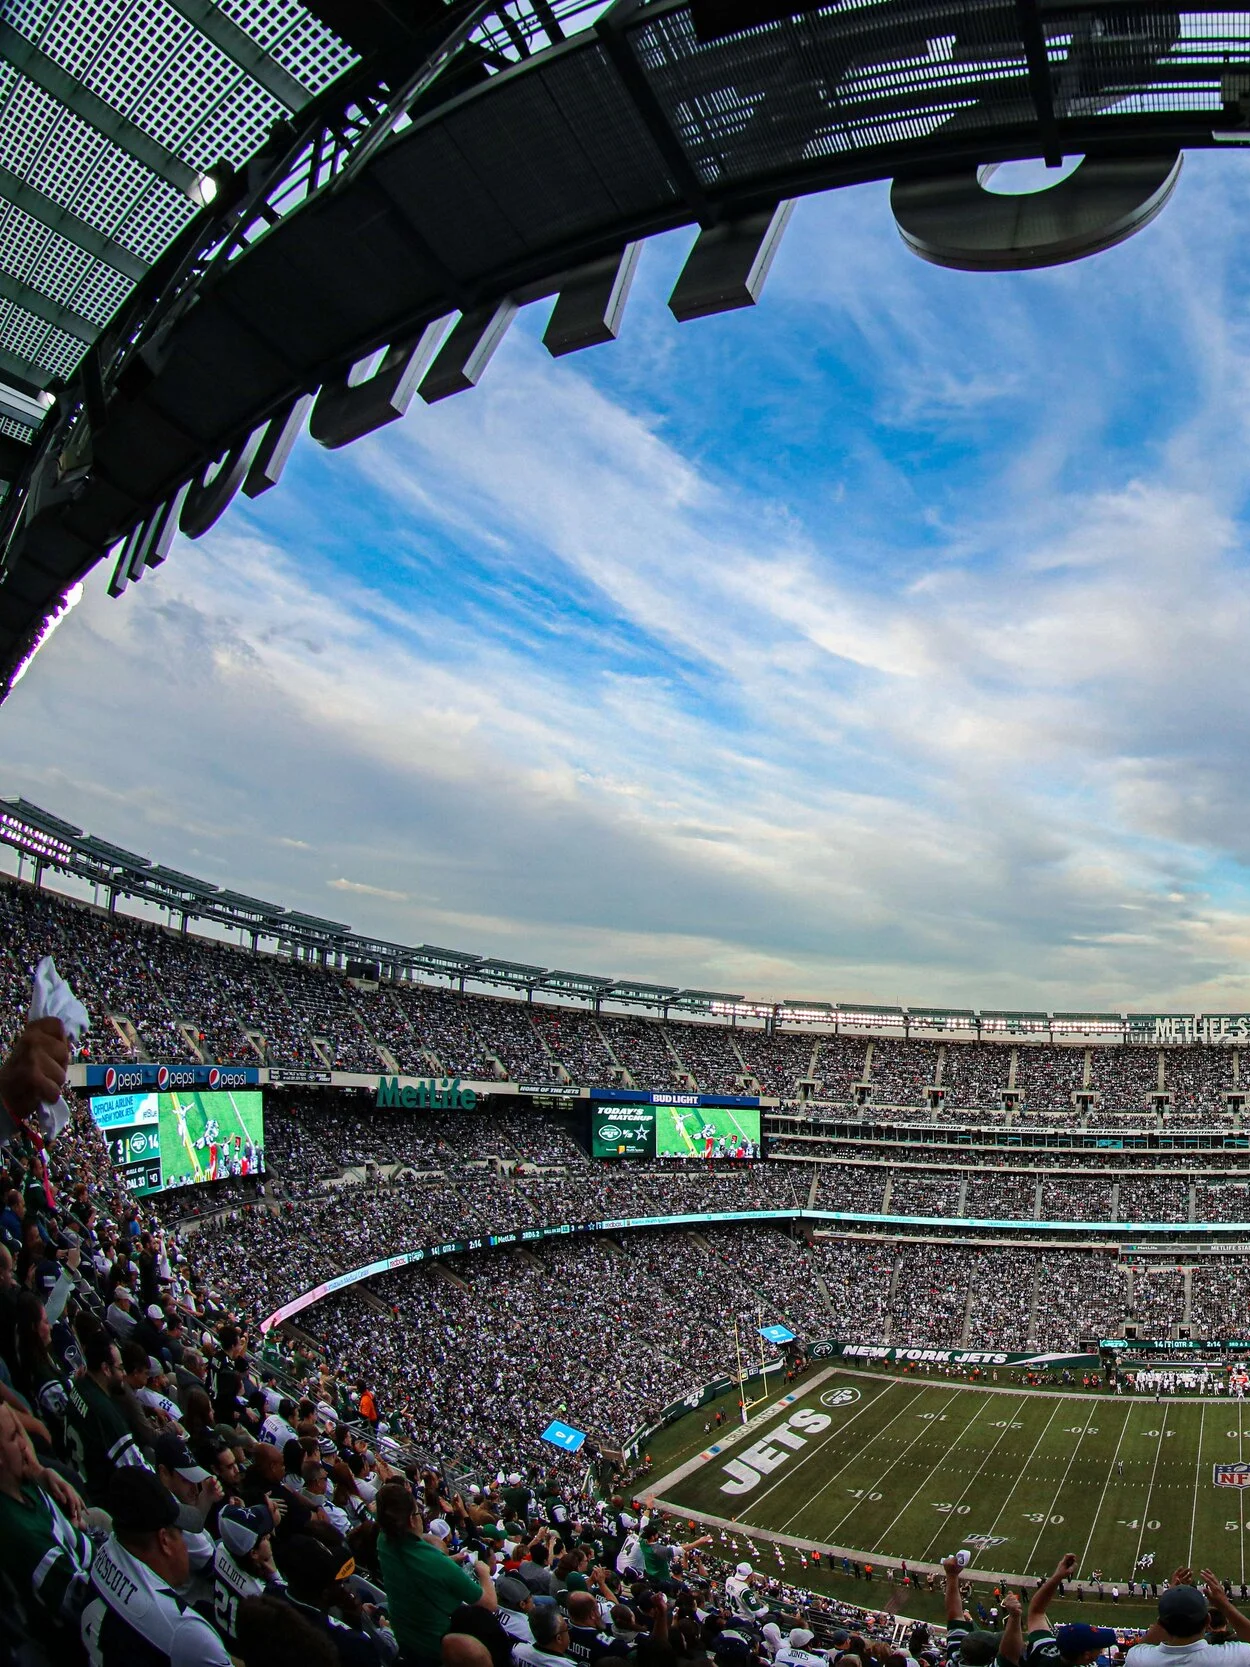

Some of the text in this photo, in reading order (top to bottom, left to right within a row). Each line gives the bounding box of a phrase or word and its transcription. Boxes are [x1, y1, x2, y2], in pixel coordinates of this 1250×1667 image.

[1155, 1017, 1230, 1038] METLIFE
[118, 1070, 143, 1090] pepsi
[170, 1068, 195, 1088] pepsi
[221, 1070, 246, 1087] pepsi
[376, 1077, 477, 1110] MetLife
[653, 1094, 699, 1104] BUD LIGHT
[94, 1096, 134, 1115] OFFICIAL AIRLINE
[597, 1107, 644, 1115] TODAY'S
[113, 1110, 124, 1121] YORK
[117, 1138, 123, 1155] 3
[148, 1133, 158, 1149] 14
[468, 1240, 482, 1249] 2:14
[498, 1234, 516, 1243] MetLife
[842, 1345, 893, 1358] NEW
[894, 1348, 951, 1361] YORK
[954, 1352, 1008, 1365] JETS
[719, 1408, 832, 1495] JETS
[851, 1490, 883, 1501] 10
[938, 1503, 971, 1514] 20
[601, 1517, 617, 1536] 24
[1029, 1512, 1065, 1524] 30
[1126, 1520, 1161, 1530] 40
[96, 1550, 138, 1605] RESCOTT
[218, 1555, 248, 1589] ELLIOTT
[214, 1580, 238, 1640] 21
[568, 1644, 591, 1659] LIOTT
[788, 1650, 809, 1661] JONES
